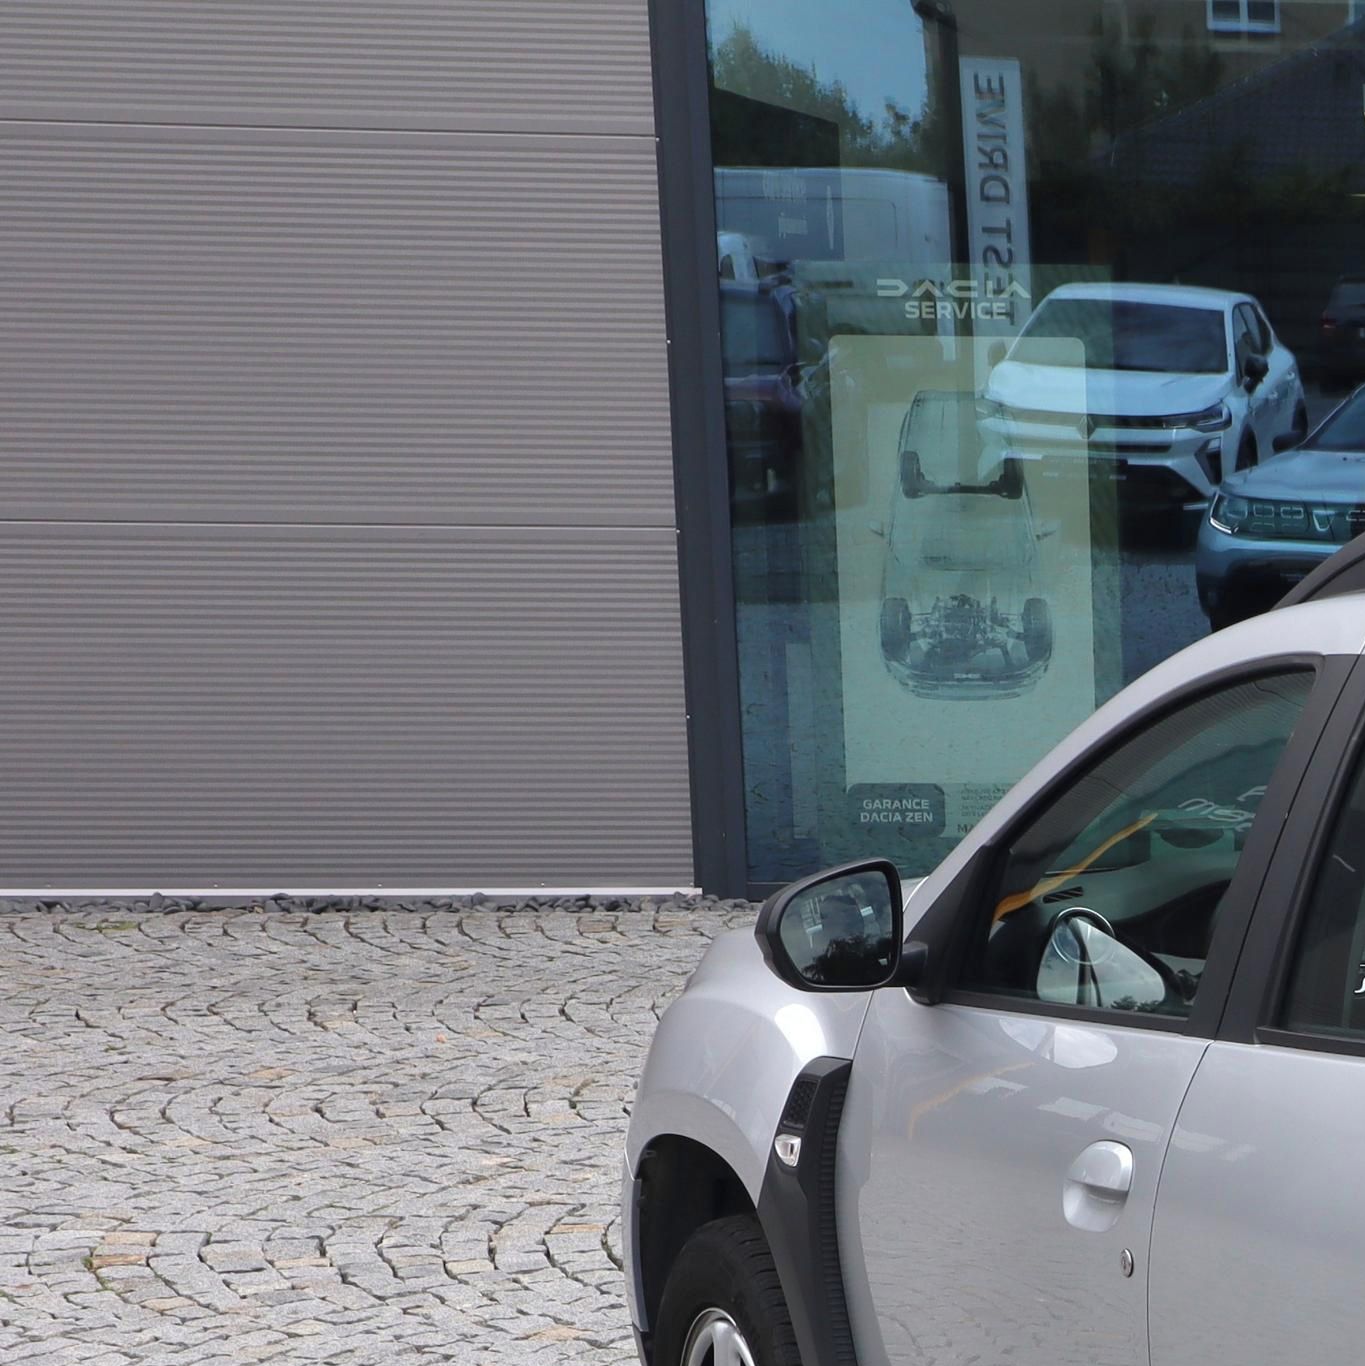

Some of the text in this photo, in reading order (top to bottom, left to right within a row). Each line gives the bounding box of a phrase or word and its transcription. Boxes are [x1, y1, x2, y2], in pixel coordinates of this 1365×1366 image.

[876, 278, 1031, 298] DACIA
[904, 301, 1008, 320] SERVICE
[862, 799, 929, 810] GARANCE
[860, 812, 933, 823] DACIA ZEN
